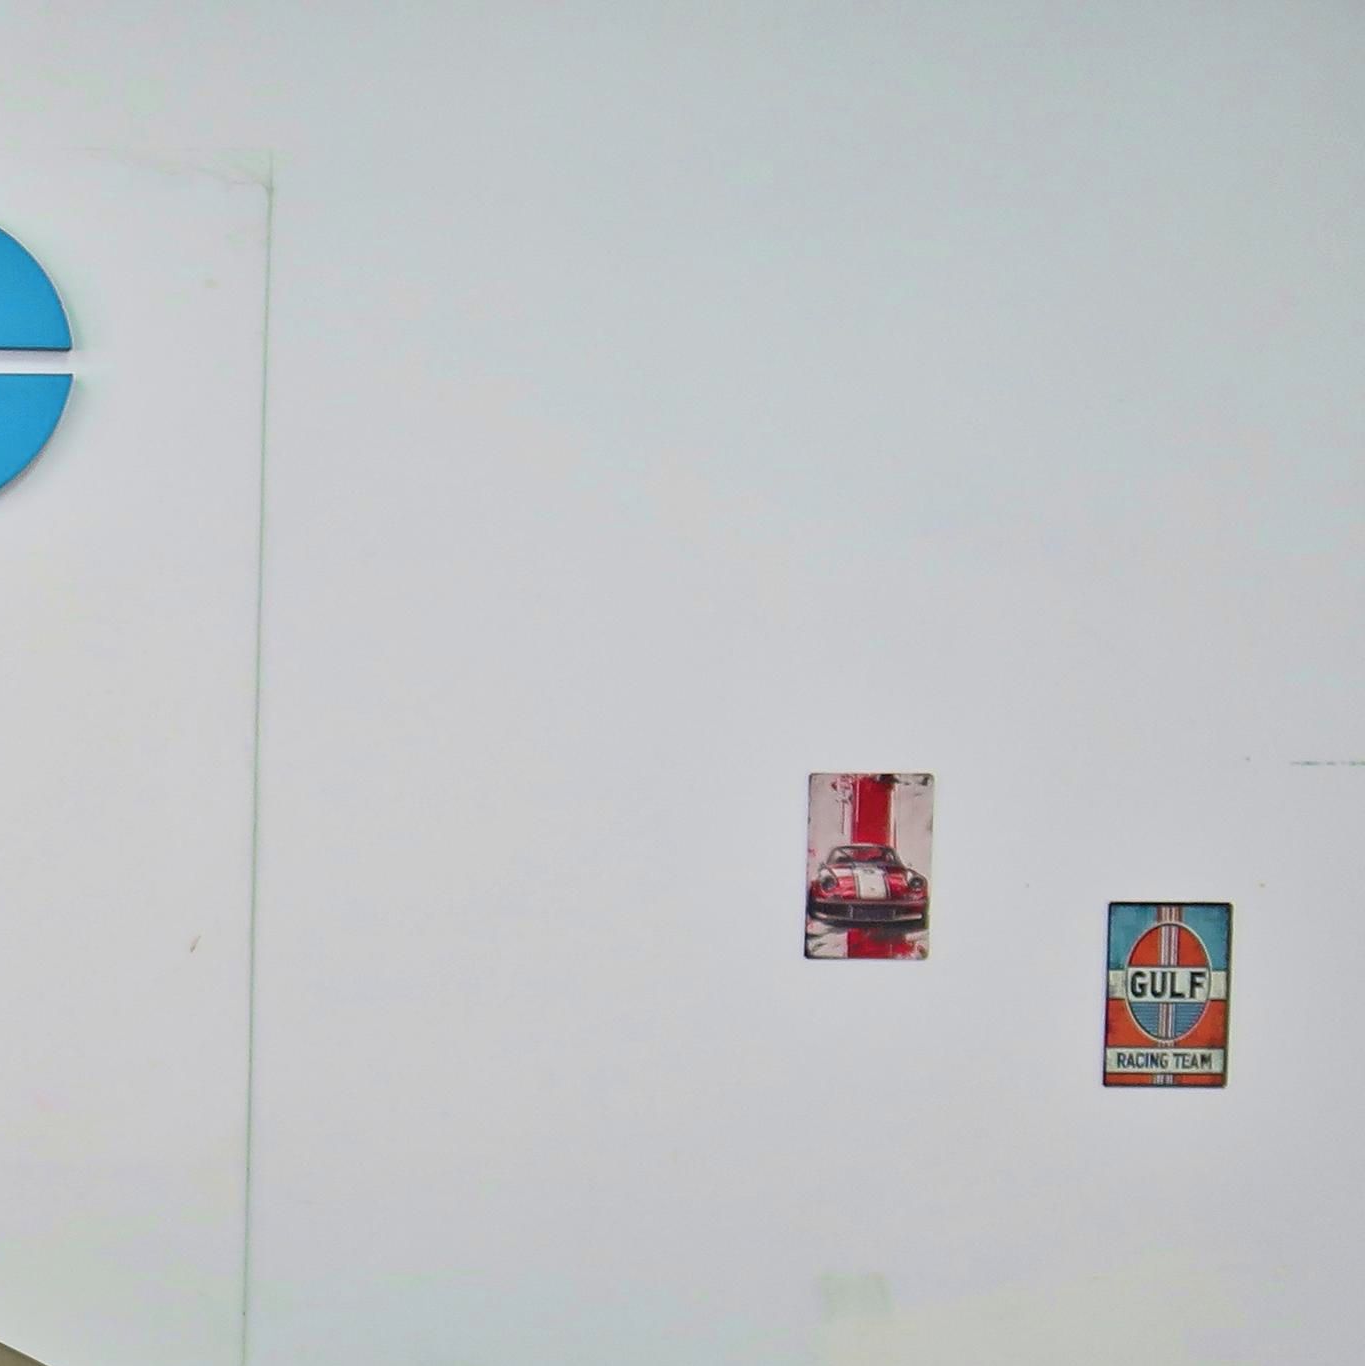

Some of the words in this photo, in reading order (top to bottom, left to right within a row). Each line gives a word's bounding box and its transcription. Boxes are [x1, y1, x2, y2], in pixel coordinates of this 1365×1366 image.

[1130, 971, 1207, 999] GULF
[1116, 1052, 1169, 1070] RACING
[1173, 1052, 1213, 1070] TEAM
